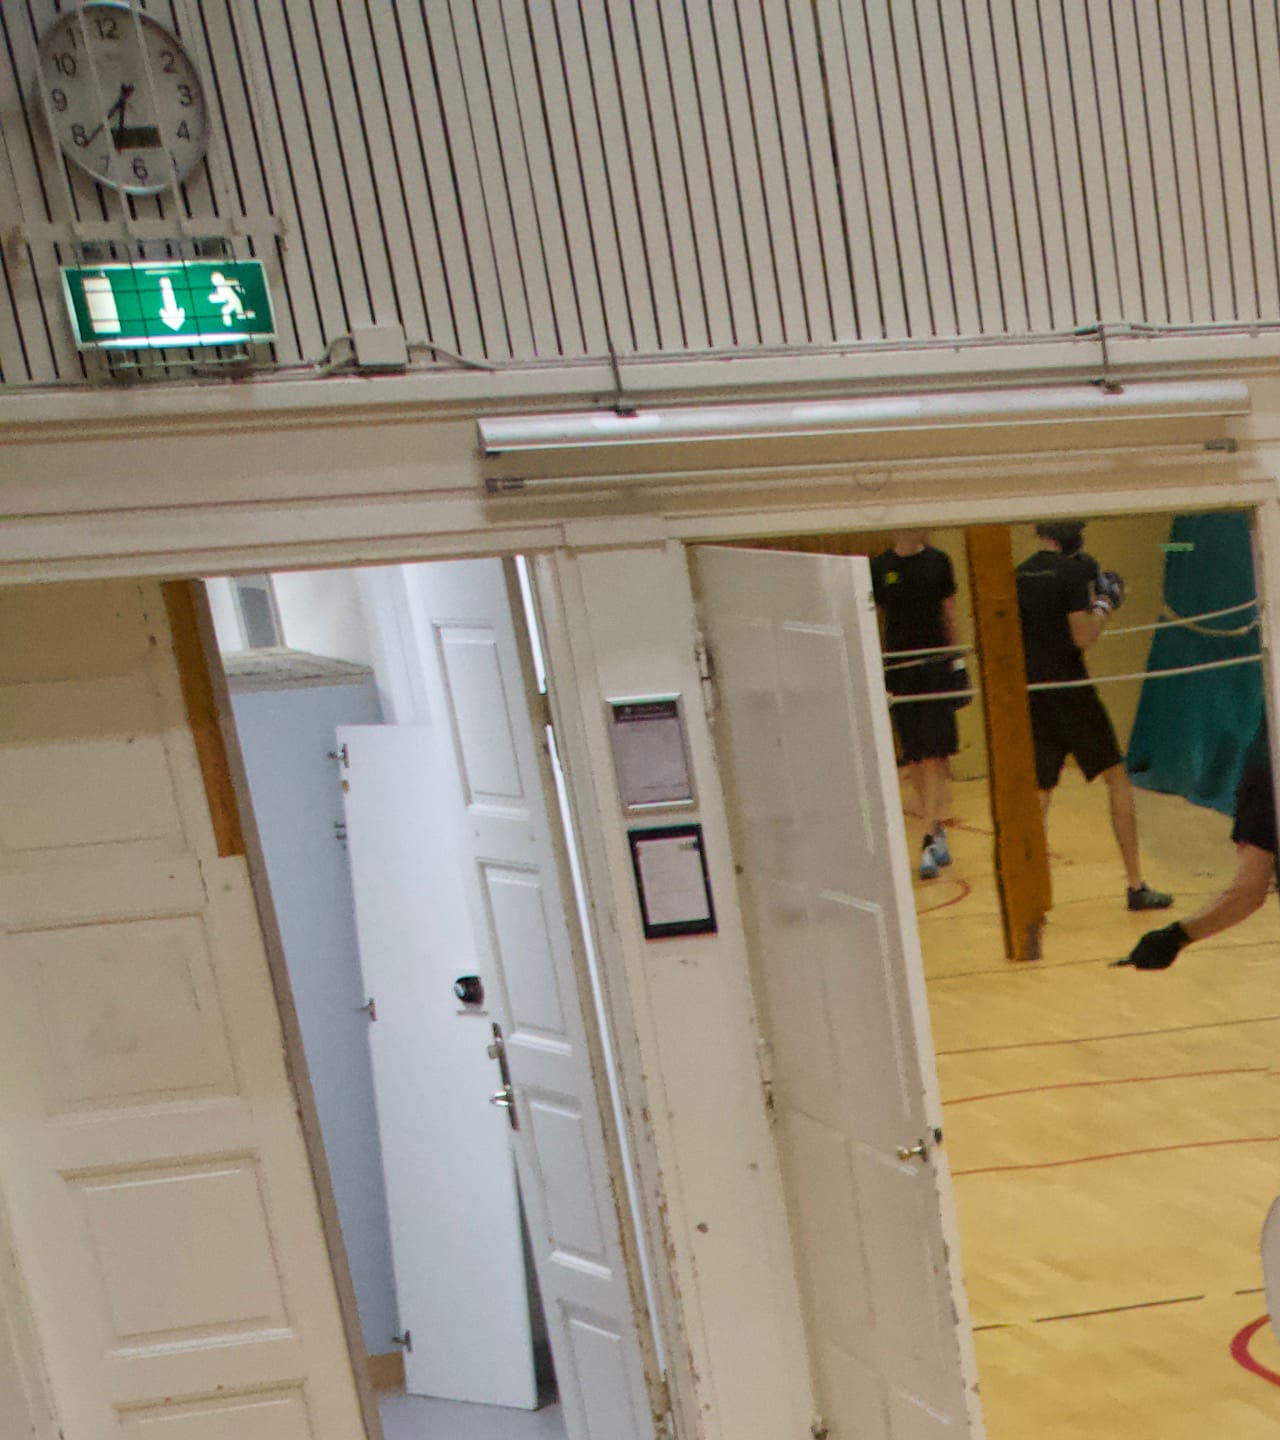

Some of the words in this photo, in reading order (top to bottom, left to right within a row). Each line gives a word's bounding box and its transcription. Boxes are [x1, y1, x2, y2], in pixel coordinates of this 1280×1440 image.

[95, 17, 120, 40] 12
[53, 52, 77, 77] 10
[160, 50, 177, 74] 2
[51, 88, 68, 112] 9
[177, 84, 193, 107] 3
[71, 123, 89, 148] 8
[176, 120, 190, 142] 4
[132, 157, 149, 181] 6
